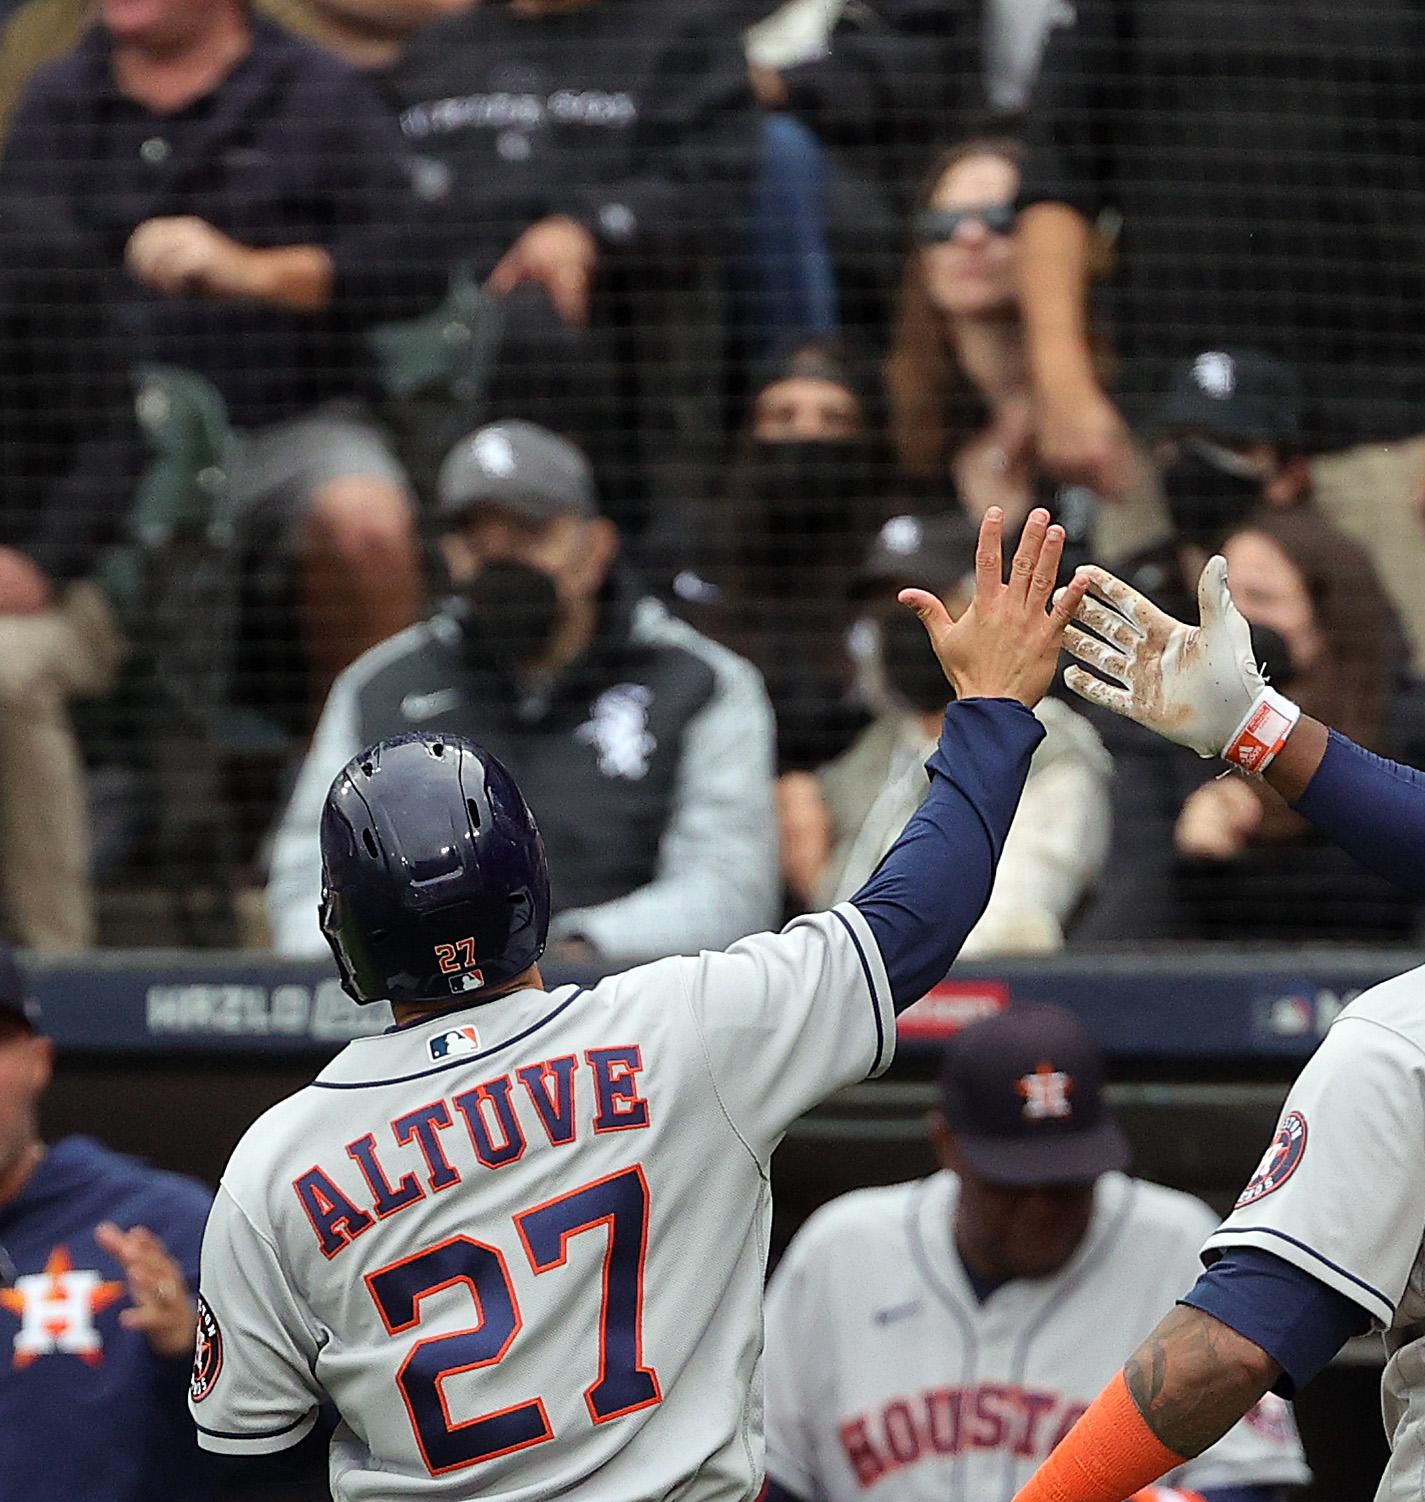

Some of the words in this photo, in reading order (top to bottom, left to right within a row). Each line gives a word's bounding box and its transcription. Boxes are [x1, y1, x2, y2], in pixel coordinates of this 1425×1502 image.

[434, 936, 476, 974] 27
[292, 1043, 651, 1260] ALTUVE
[363, 1163, 663, 1478] 27
